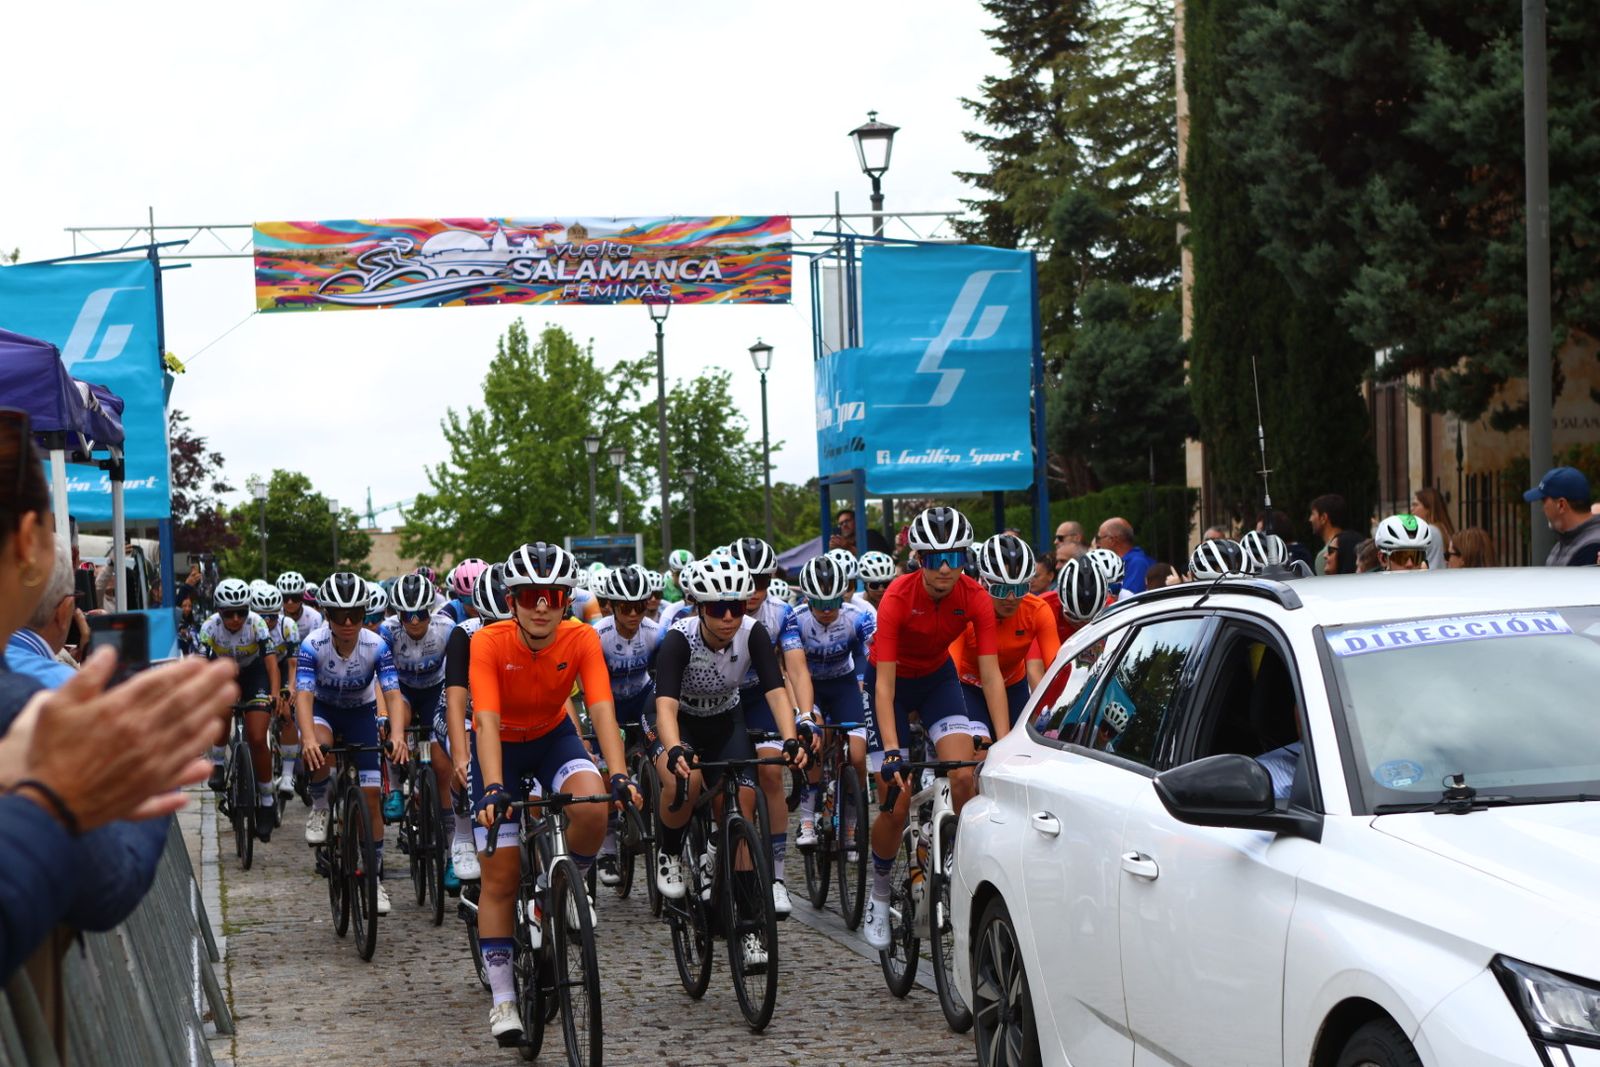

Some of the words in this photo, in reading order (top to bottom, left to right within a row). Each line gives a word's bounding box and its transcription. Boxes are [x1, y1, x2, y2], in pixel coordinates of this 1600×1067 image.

[553, 240, 633, 257] vuelta
[511, 258, 724, 283] SALAMANCA
[561, 281, 672, 297] FÉMINAS
[968, 447, 1024, 466] Sport
[1344, 616, 1560, 652] DIRECCIÓN
